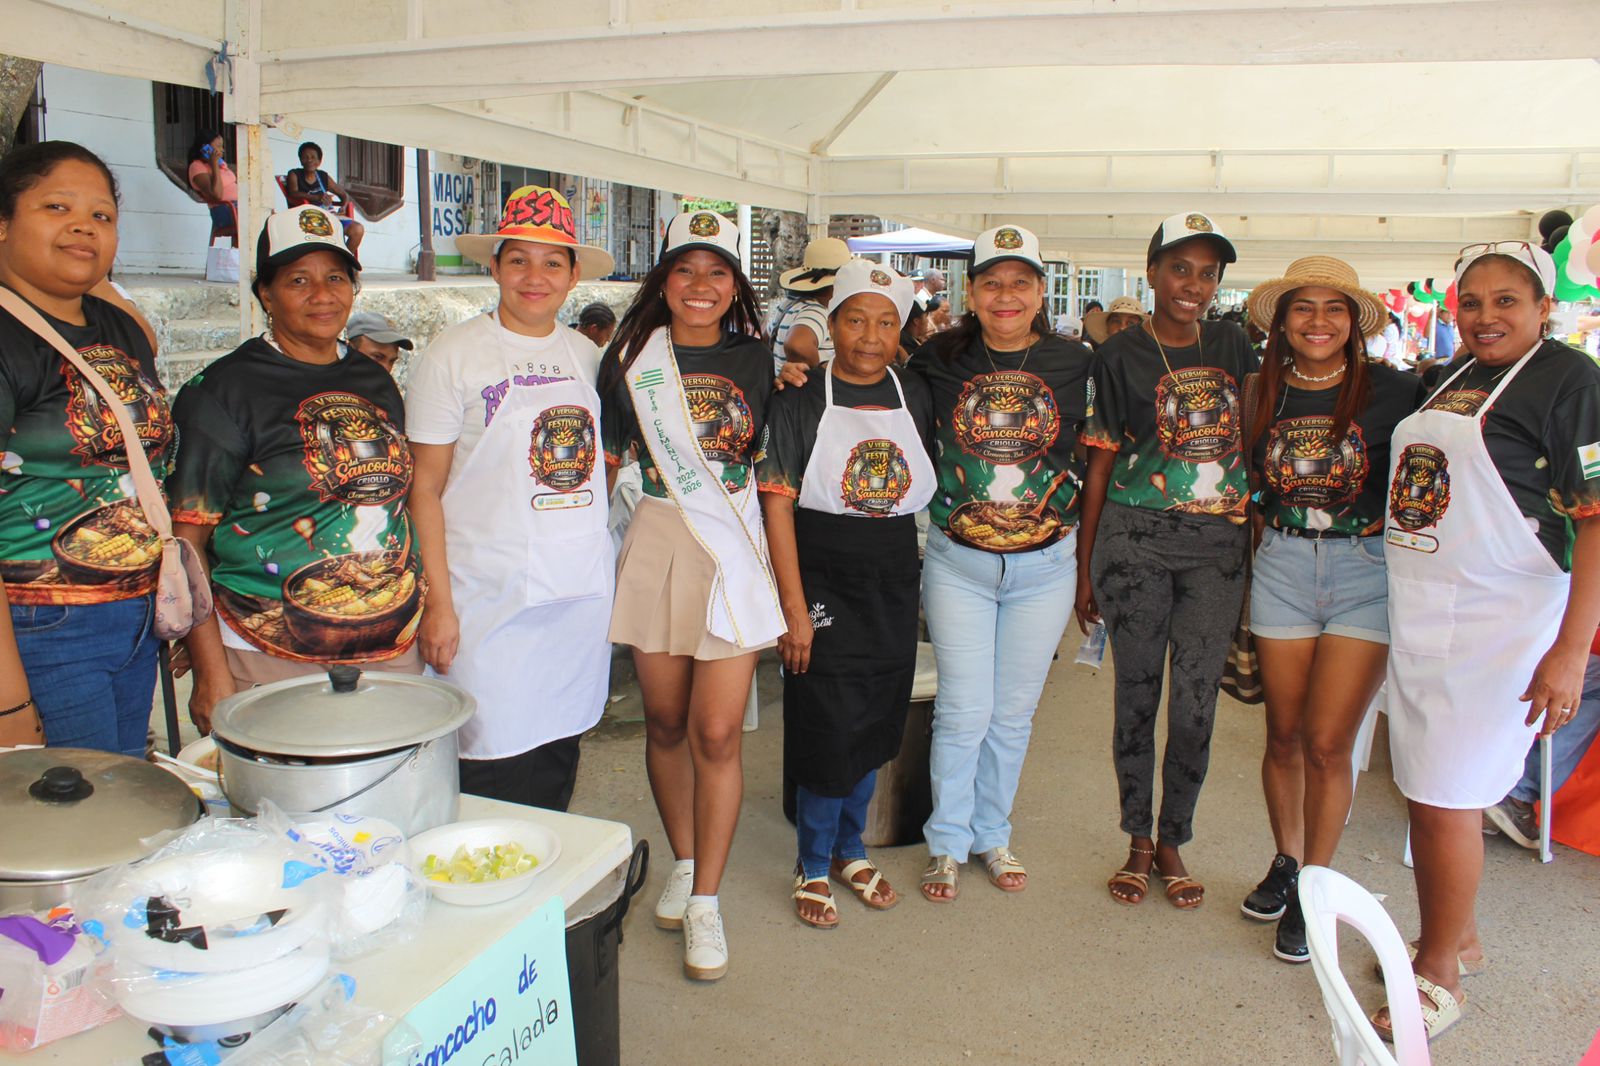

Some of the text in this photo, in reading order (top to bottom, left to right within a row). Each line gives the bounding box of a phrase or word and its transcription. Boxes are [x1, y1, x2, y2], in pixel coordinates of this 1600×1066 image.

[96, 364, 132, 376] STIVAL
[685, 390, 725, 400] STIVAL
[983, 386, 1033, 396] FESTIVAL
[1175, 381, 1220, 394] FESTIVAL
[322, 408, 372, 421] FESTIVAL
[548, 420, 582, 428] FESTIVAL
[971, 426, 1039, 442] Sancocho
[1176, 422, 1231, 445] Sancocho
[335, 456, 403, 485] Sancocho
[543, 459, 585, 475] Sancocho
[676, 469, 696, 484] 2025
[1281, 473, 1344, 493] Sancocho
[681, 480, 702, 495] 2026
